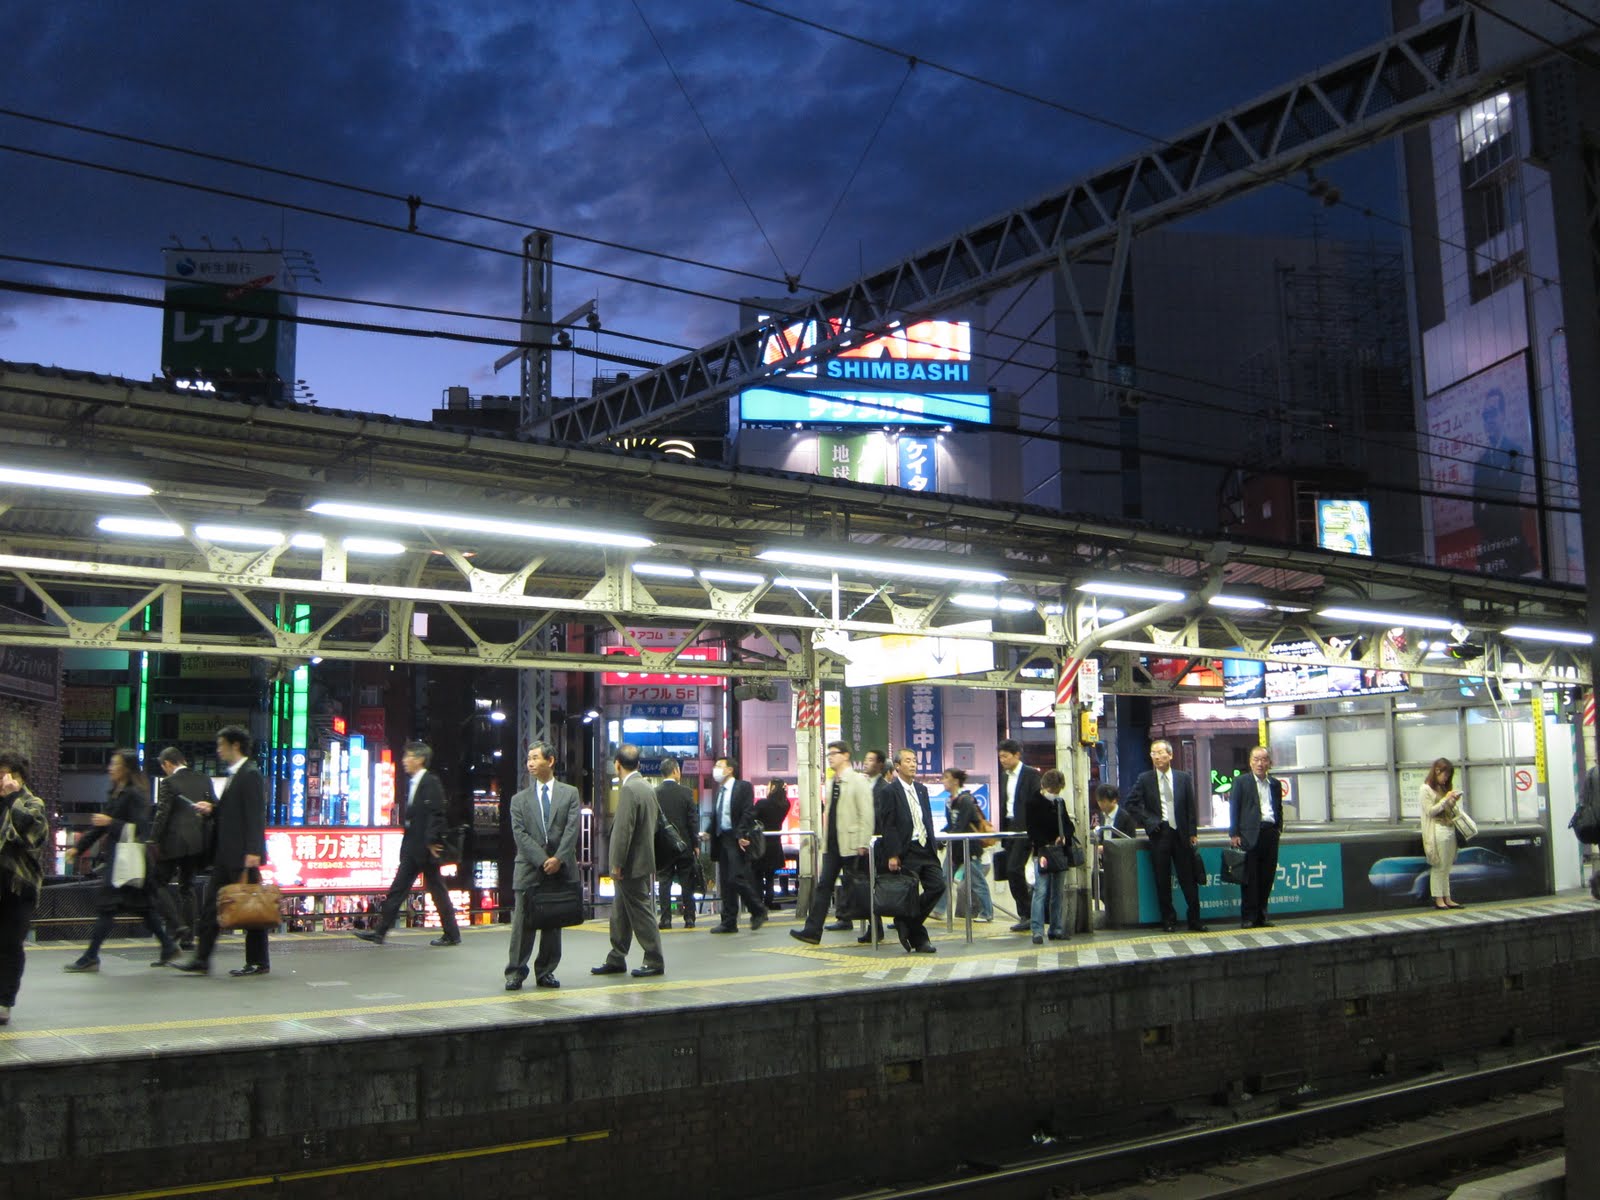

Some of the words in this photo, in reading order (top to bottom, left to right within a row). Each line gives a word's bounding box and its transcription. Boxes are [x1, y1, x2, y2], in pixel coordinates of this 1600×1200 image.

[173, 311, 269, 344] レイク
[827, 360, 969, 382] SHIMBASHI
[637, 631, 663, 640] アコム
[627, 687, 672, 699] アイフル
[675, 687, 695, 699] 5F
[295, 834, 382, 860] 精力減退
